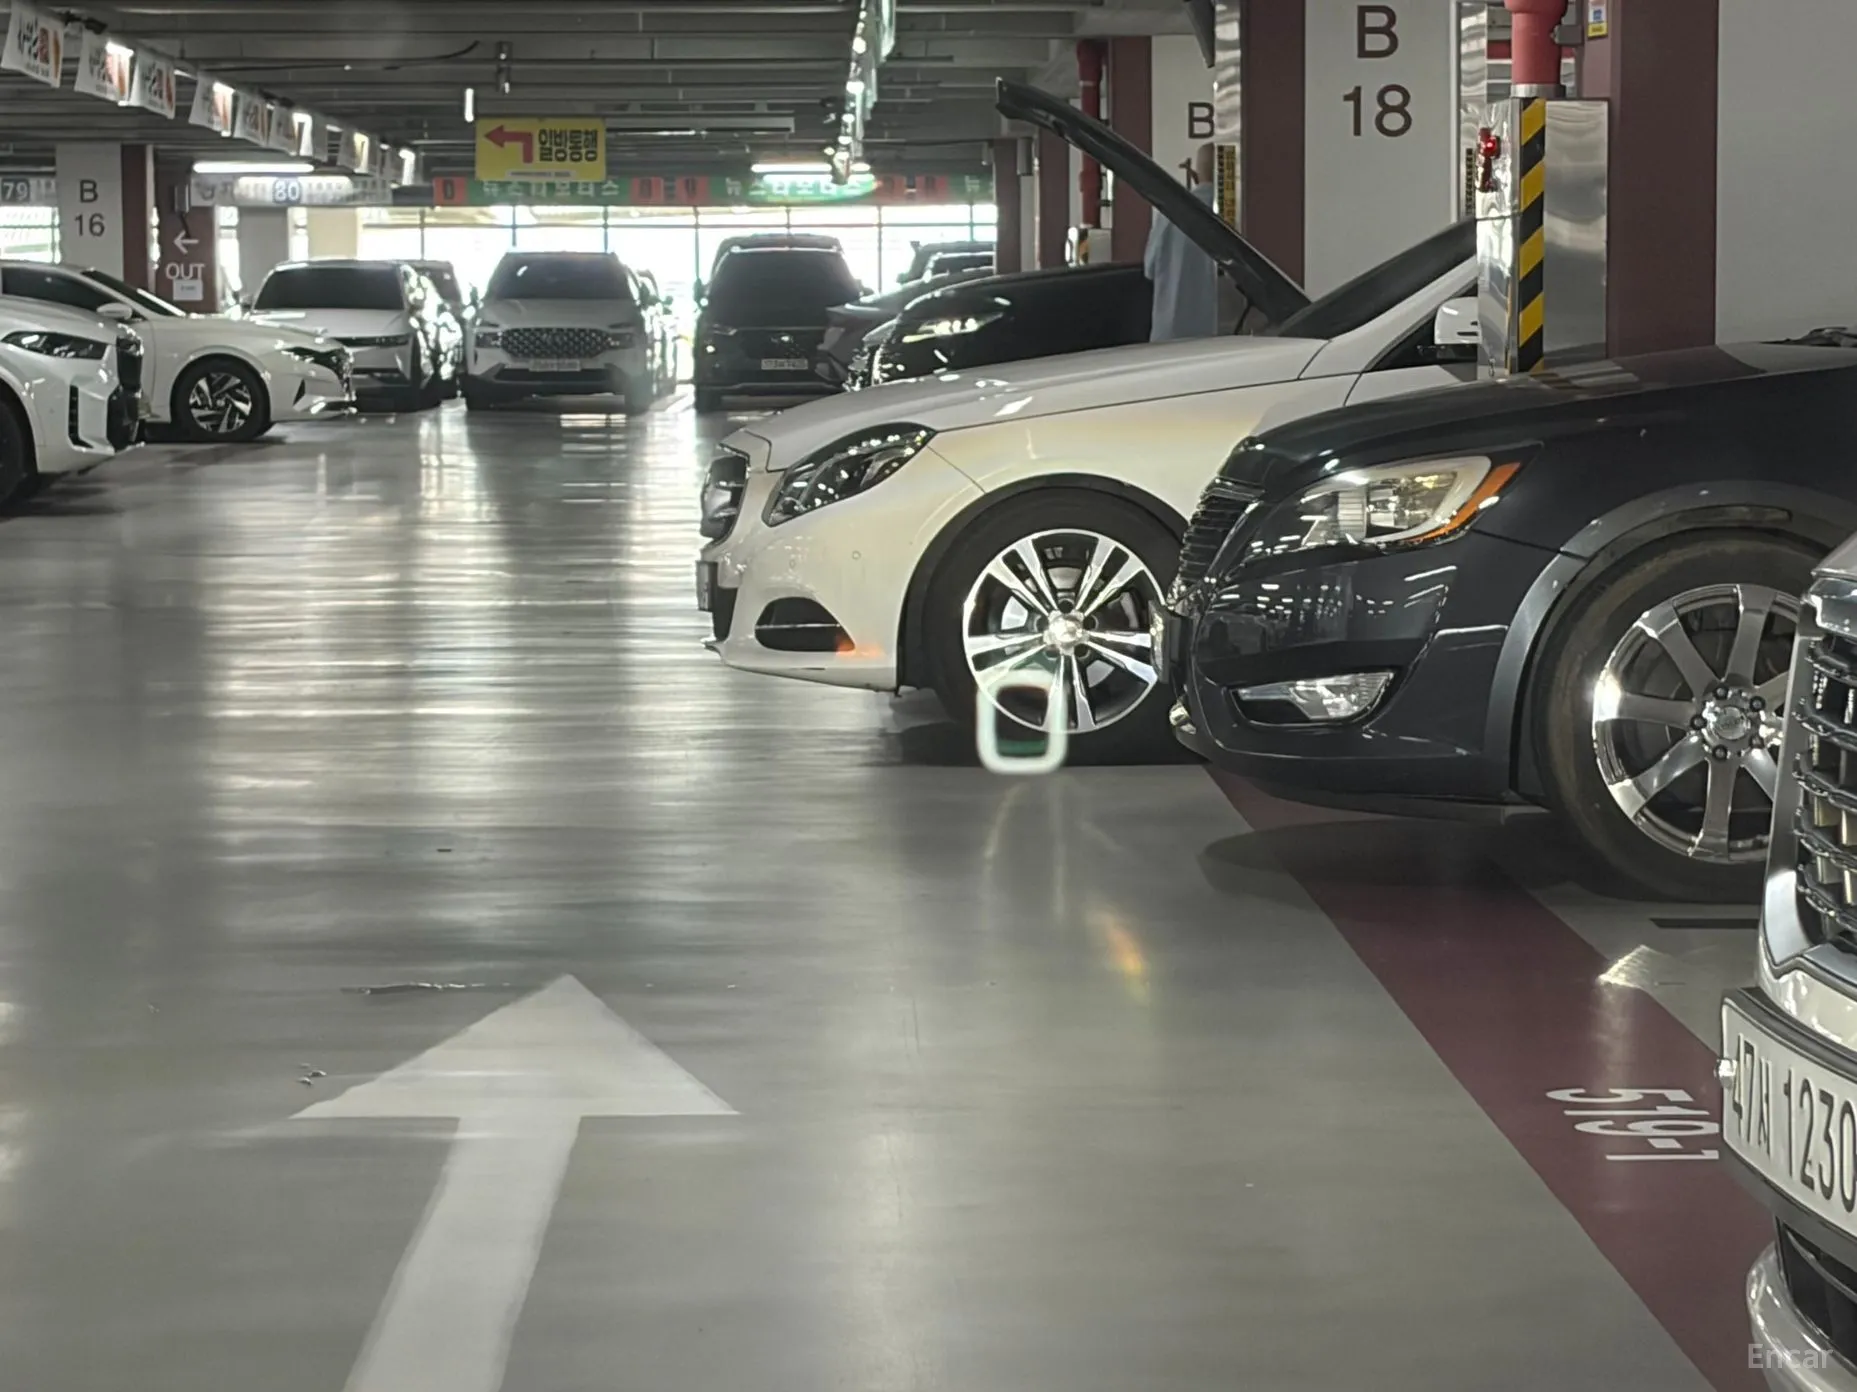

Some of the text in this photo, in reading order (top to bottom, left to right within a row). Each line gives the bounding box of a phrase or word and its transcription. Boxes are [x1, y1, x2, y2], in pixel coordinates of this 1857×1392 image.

[1356, 4, 1398, 58] B
[1188, 102, 1215, 138] B
[1343, 84, 1412, 138] 18
[538, 128, 598, 162] 일방통행
[2, 182, 29, 201] 79
[80, 180, 98, 203] B
[273, 179, 300, 201] 80
[75, 213, 105, 237] 16
[165, 261, 206, 281] OUT
[1546, 1088, 1719, 1161] 519-1
[1784, 1067, 1857, 1213] 1230
